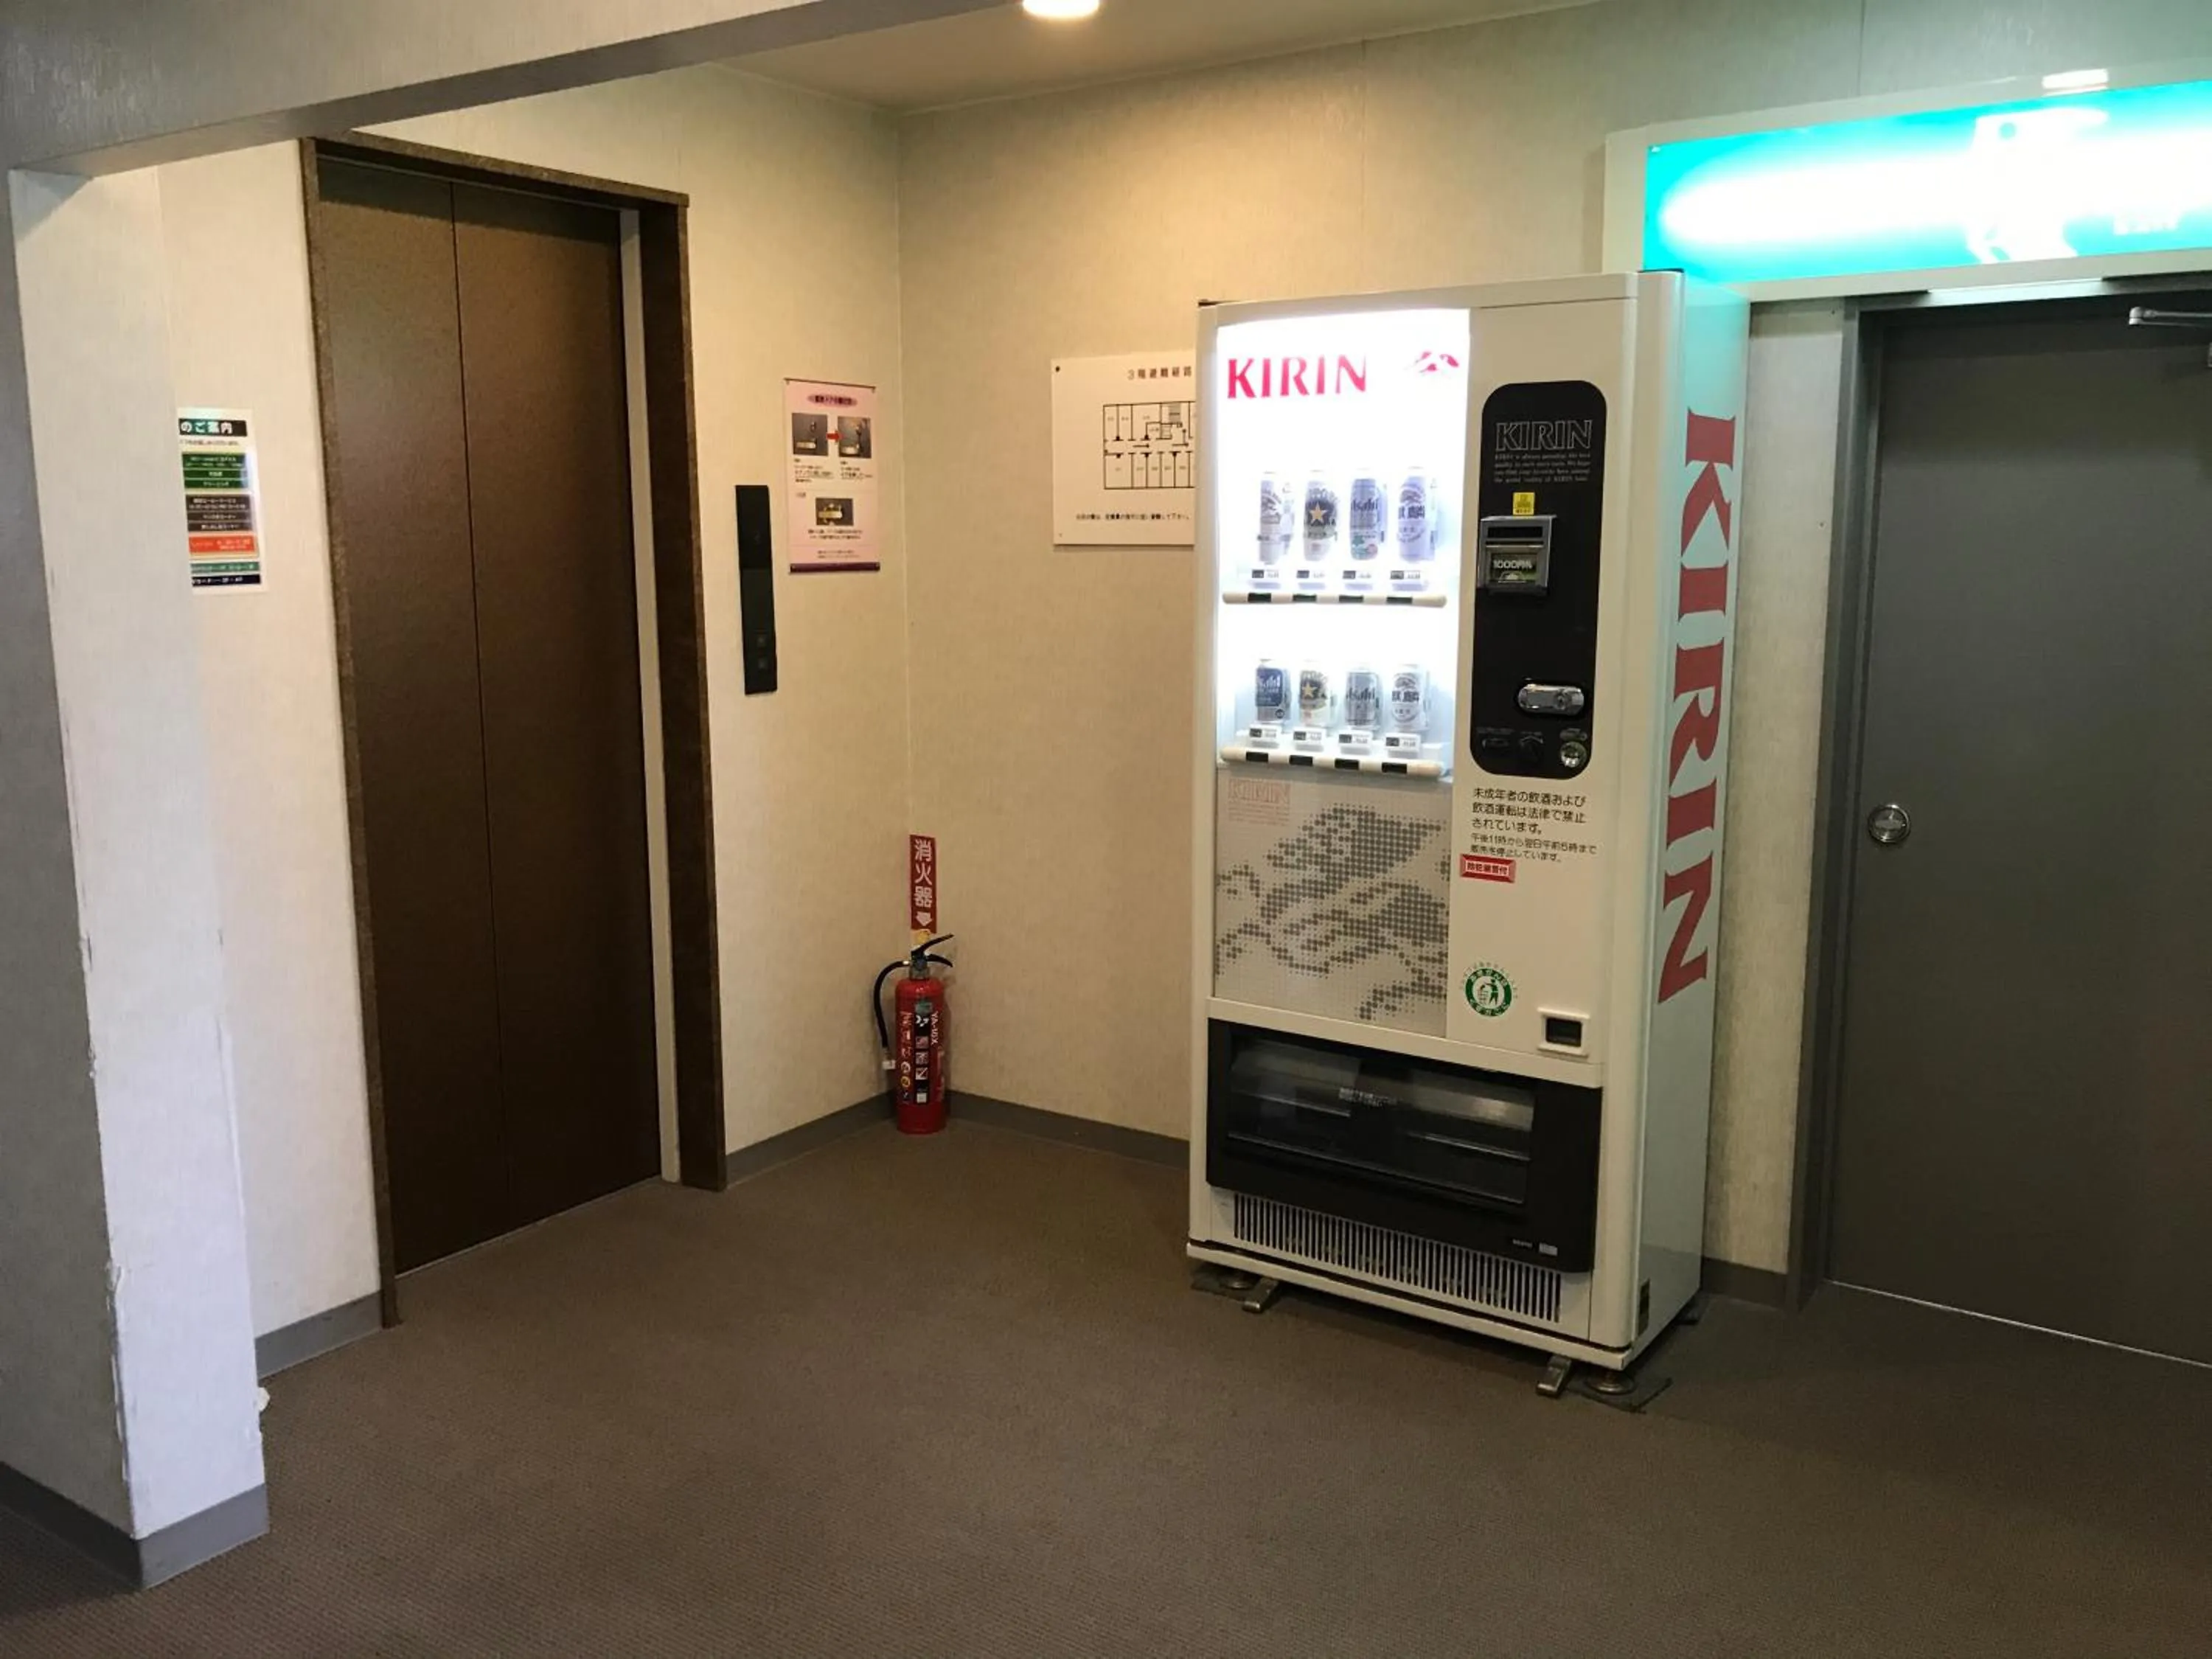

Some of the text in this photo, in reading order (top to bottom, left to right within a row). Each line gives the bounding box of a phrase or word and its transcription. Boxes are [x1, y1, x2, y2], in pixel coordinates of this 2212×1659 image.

[1227, 354, 1366, 399] KIRIN
[1495, 419, 1593, 451] KIRIN
[1658, 407, 1736, 1004] KIRIN
[1472, 802, 1586, 824] 飲酒運転は法律で禁止
[1474, 787, 1586, 807] 未成年者の飲酒および
[1472, 818, 1542, 834] されています。
[915, 839, 933, 908] 消火器
